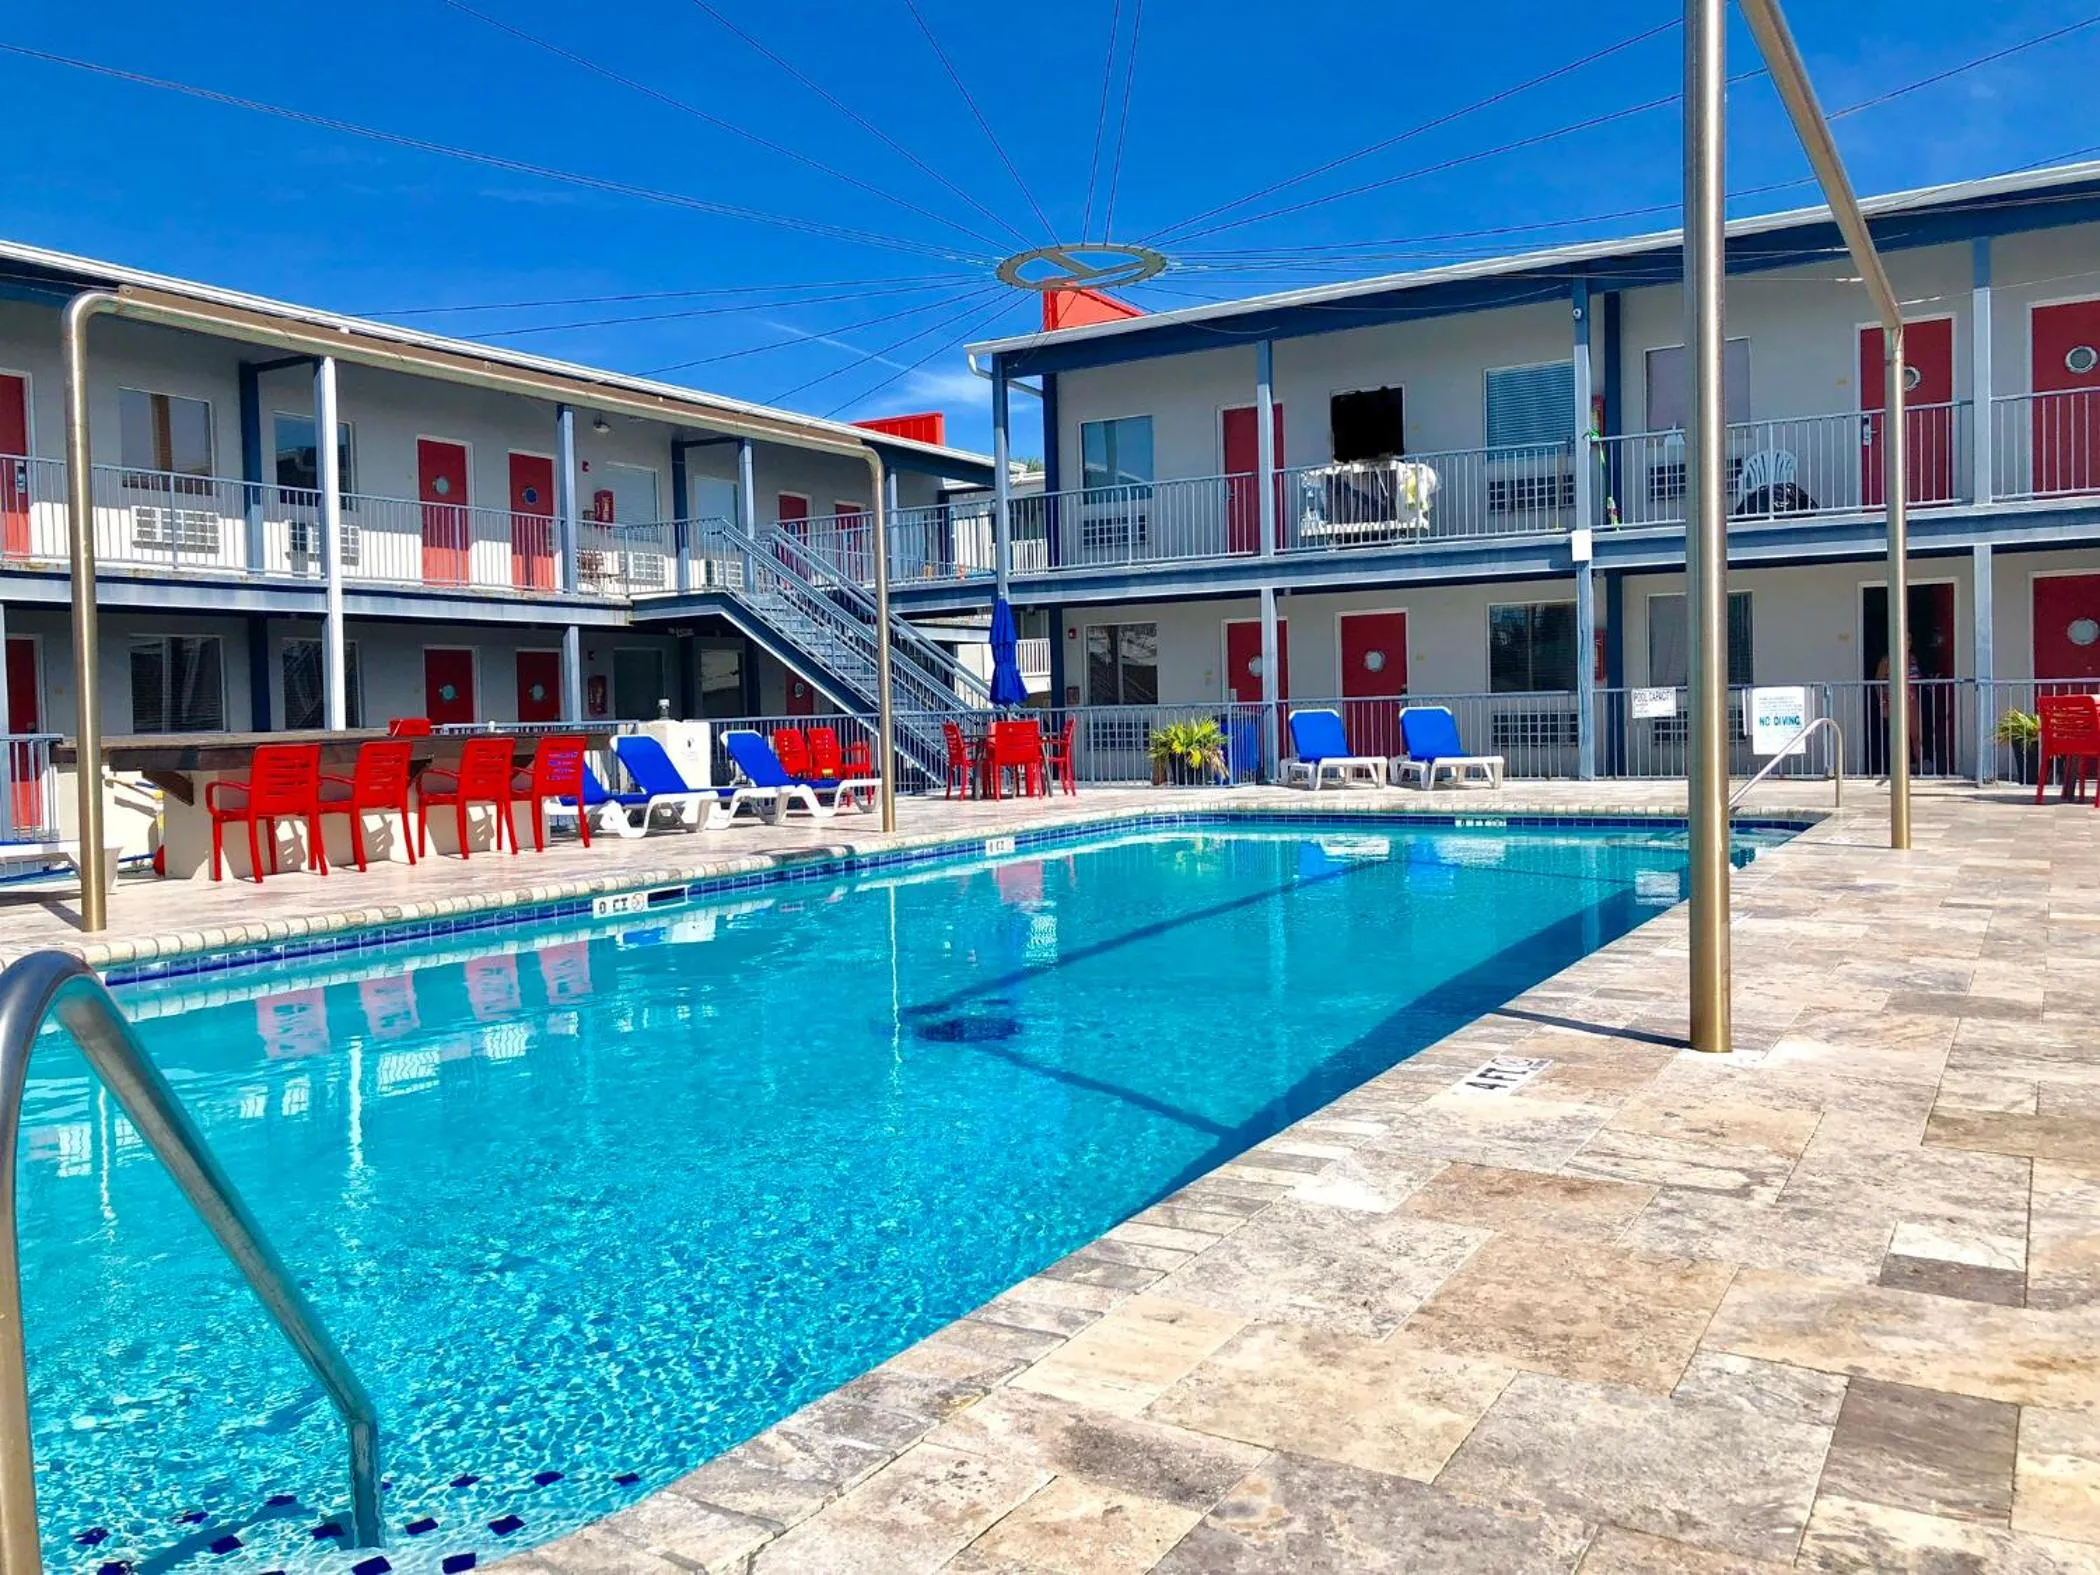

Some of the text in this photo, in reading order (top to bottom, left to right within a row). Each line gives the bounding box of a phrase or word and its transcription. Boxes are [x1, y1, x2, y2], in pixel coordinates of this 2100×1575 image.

[1634, 689, 1673, 702] POOL CAPACITY
[1759, 714, 1801, 727] NO DIVING
